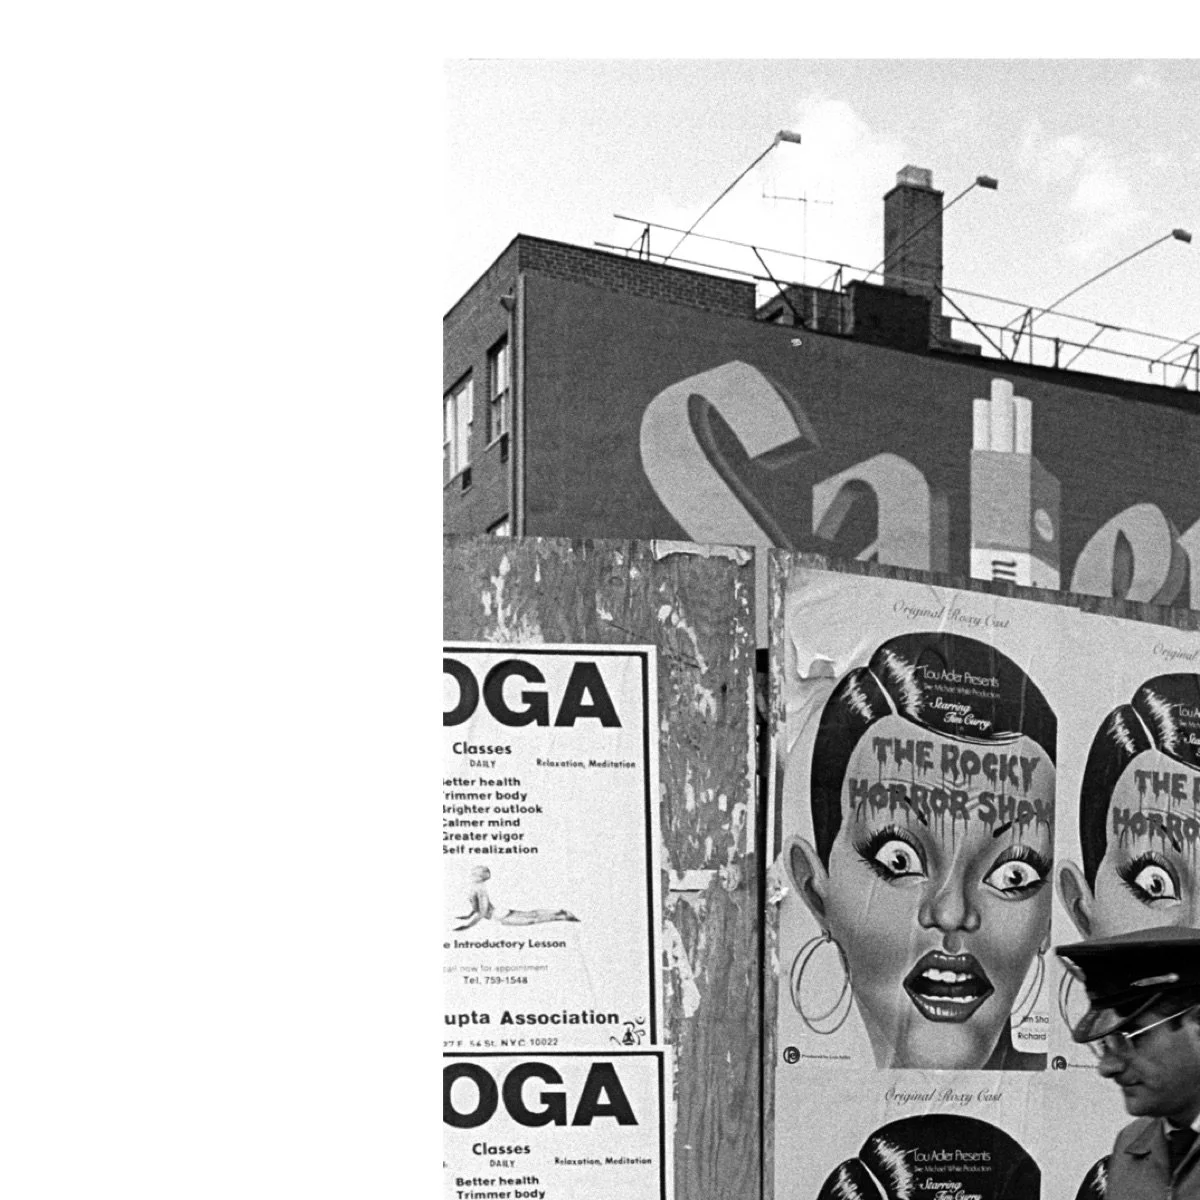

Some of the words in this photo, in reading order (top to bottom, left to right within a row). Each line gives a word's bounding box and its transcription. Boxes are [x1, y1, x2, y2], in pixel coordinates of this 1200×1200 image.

[929, 697, 971, 716] Starring
[452, 741, 512, 755] Classes
[469, 760, 496, 769] DAILY
[872, 736, 934, 772] THE
[941, 744, 1040, 788] ROCKY
[479, 777, 521, 787] health
[1134, 769, 1187, 800] THE
[443, 790, 492, 801] rimmer
[495, 790, 527, 802] body
[850, 778, 970, 822] HORROR
[494, 804, 543, 814] outlook
[488, 818, 520, 827] mind
[491, 831, 524, 843] vigor
[443, 845, 465, 854] Self
[469, 845, 538, 855] realization
[454, 939, 525, 950] Introductory
[528, 939, 566, 948] Lesson
[500, 1009, 619, 1025] Association
[443, 1061, 639, 1129] OGA
[885, 1088, 937, 1106] Original
[938, 1088, 973, 1106] Roxy
[977, 1088, 1002, 1101] Cast
[472, 1142, 531, 1155] Classes
[955, 1150, 991, 1161] Presents
[489, 1159, 515, 1168] DAILY
[605, 1156, 652, 1165] Meditation
[456, 1176, 496, 1187] Better
[499, 1176, 539, 1186] health
[920, 1177, 962, 1193] Starring
[456, 1190, 511, 1199] Trimmer
[515, 1189, 545, 1200] body
